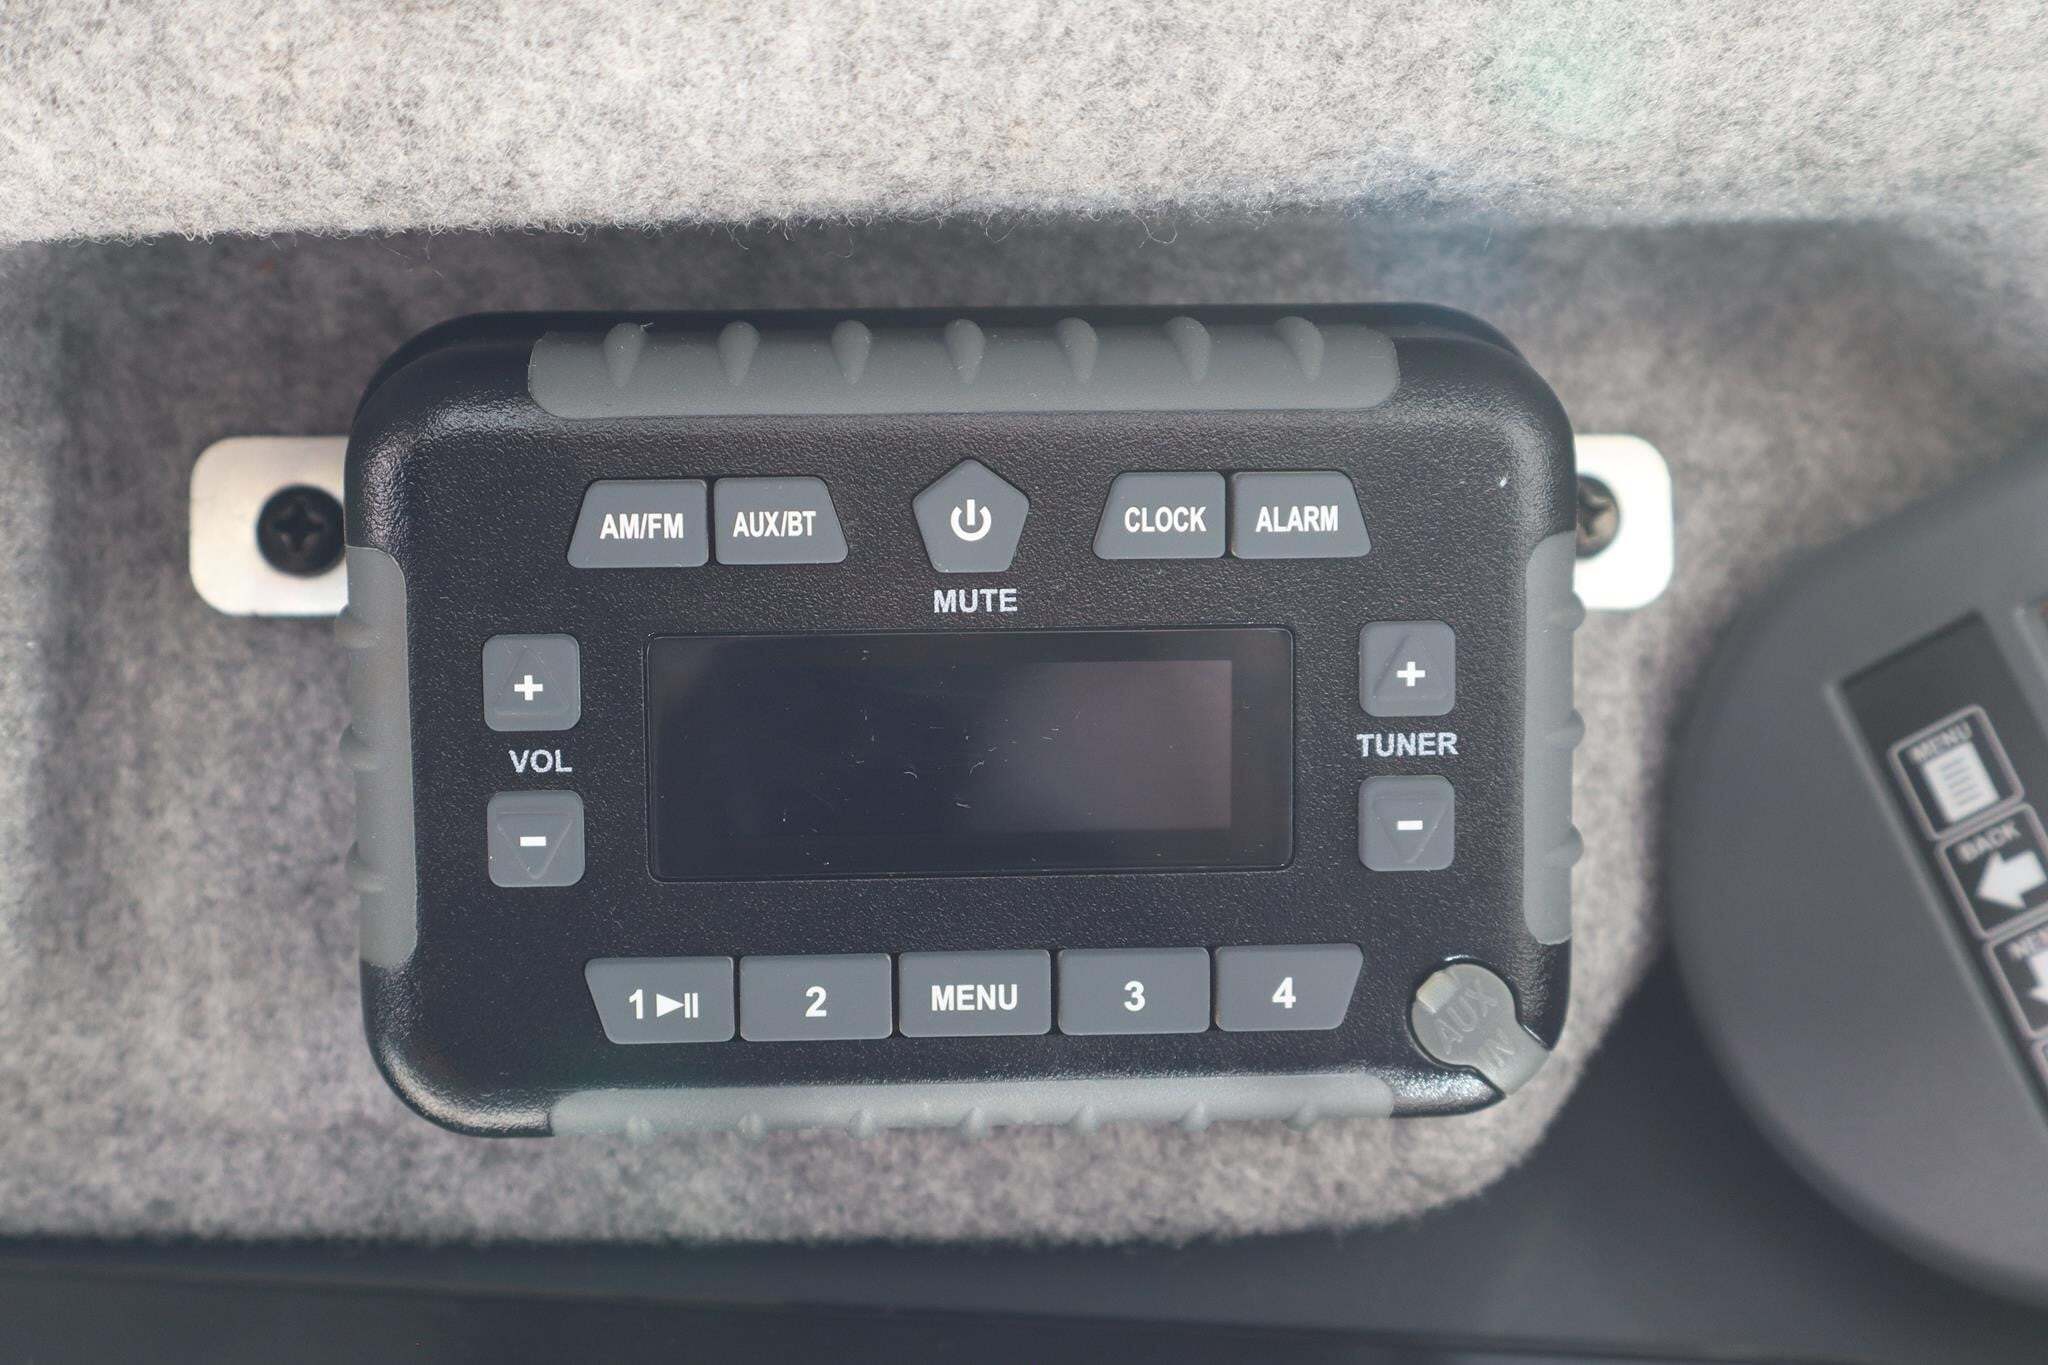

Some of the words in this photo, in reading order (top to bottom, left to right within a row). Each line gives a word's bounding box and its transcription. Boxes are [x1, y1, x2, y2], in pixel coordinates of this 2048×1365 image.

[599, 512, 684, 540] AM/FM
[732, 510, 816, 538] AUX/BT
[1124, 506, 1207, 533] CLOCK
[1255, 505, 1339, 533] ALARM
[933, 588, 1018, 613] MUTE
[1356, 731, 1459, 757] TUNER
[1906, 720, 1973, 765] MENU
[508, 749, 573, 773] VOL
[629, 988, 644, 1020] 1
[805, 985, 827, 1018] 2
[931, 983, 1018, 1012] MENU
[1124, 980, 1146, 1012] 3
[1271, 976, 1297, 1009] 4
[1437, 977, 1499, 1056] AUX
